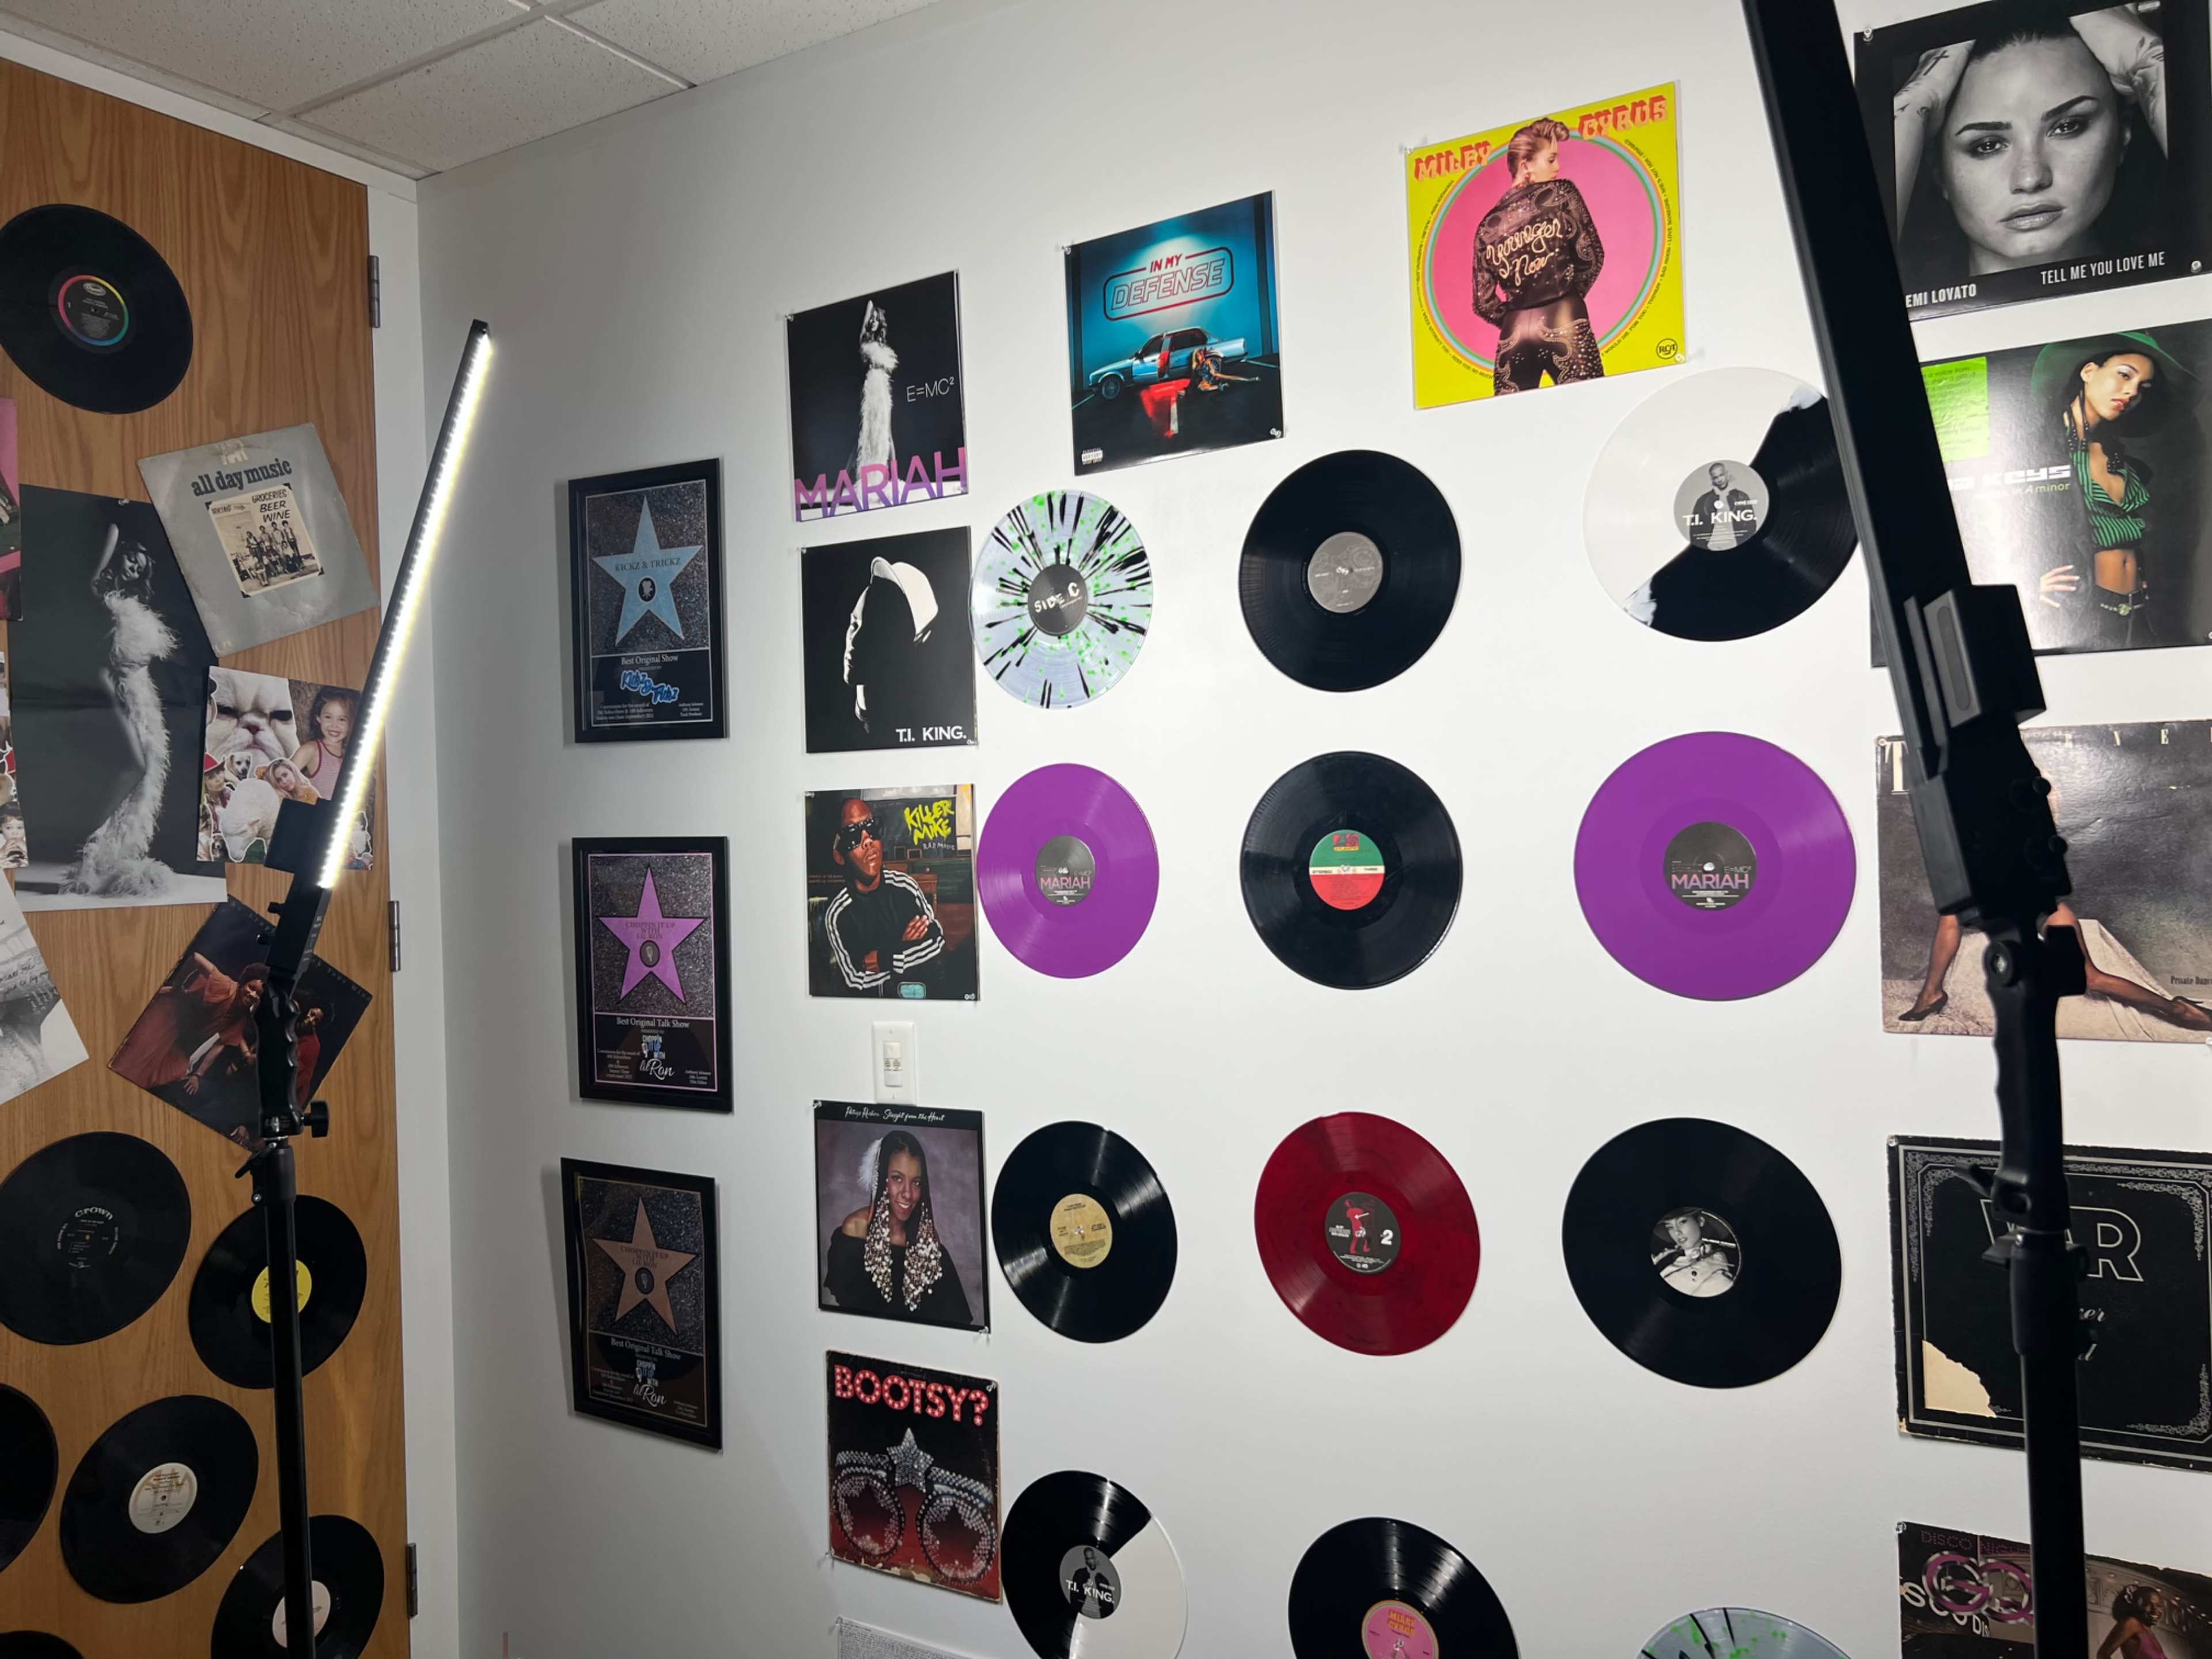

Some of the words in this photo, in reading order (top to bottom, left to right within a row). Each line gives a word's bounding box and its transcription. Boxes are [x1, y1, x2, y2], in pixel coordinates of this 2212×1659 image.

[1414, 140, 1493, 183] MILEY
[1578, 94, 1668, 141] CYRUS
[1149, 258, 1163, 273] IN
[1165, 253, 1183, 269] MY
[2041, 268, 2067, 285] TELL
[2070, 264, 2086, 280] ME
[2090, 260, 2113, 276] YOU
[2116, 255, 2145, 272] LOVE
[2148, 251, 2165, 267] ME
[1111, 257, 1225, 310] DEFENSE
[1906, 293, 1928, 308] EMI
[1931, 283, 1976, 304] LOVATO
[191, 474, 215, 497] all
[215, 471, 244, 490] day
[243, 458, 292, 484] music
[794, 446, 969, 522] MARIAH
[2036, 482, 2071, 493] minor
[260, 500, 286, 513] BEER
[263, 510, 291, 523] WINE
[1682, 514, 1703, 526] T.I.
[1711, 509, 1757, 524] KING.
[615, 561, 641, 572] KICKZ
[641, 561, 649, 569] &
[651, 558, 681, 569] TRICKZ
[1034, 593, 1065, 613] SIDE
[1067, 582, 1080, 597] C
[621, 657, 635, 665] Best
[635, 654, 661, 666] Original
[661, 654, 679, 663] Show
[896, 728, 915, 743] T.I.
[922, 725, 967, 741] KING.
[904, 799, 955, 831] KILLER
[914, 817, 952, 846] MIKE
[1040, 876, 1090, 890] MARIAH
[1671, 873, 1749, 889] MARIAH
[616, 1017, 629, 1025] Best
[630, 1018, 656, 1028] Original
[657, 1019, 671, 1028] Talk
[672, 1020, 690, 1029] Show
[648, 1058, 675, 1081] Ron
[927, 1111, 945, 1123] Heart
[1381, 1229, 1393, 1245] 2
[611, 1338, 624, 1347] Best
[624, 1340, 650, 1353] Original
[664, 1349, 681, 1360] Show
[642, 1384, 666, 1407] Ron
[835, 1364, 989, 1427] BOOTSY?
[1921, 1530, 1973, 1551] DISCO
[1065, 1579, 1079, 1592] T.I.
[1084, 1585, 1115, 1604] KING.
